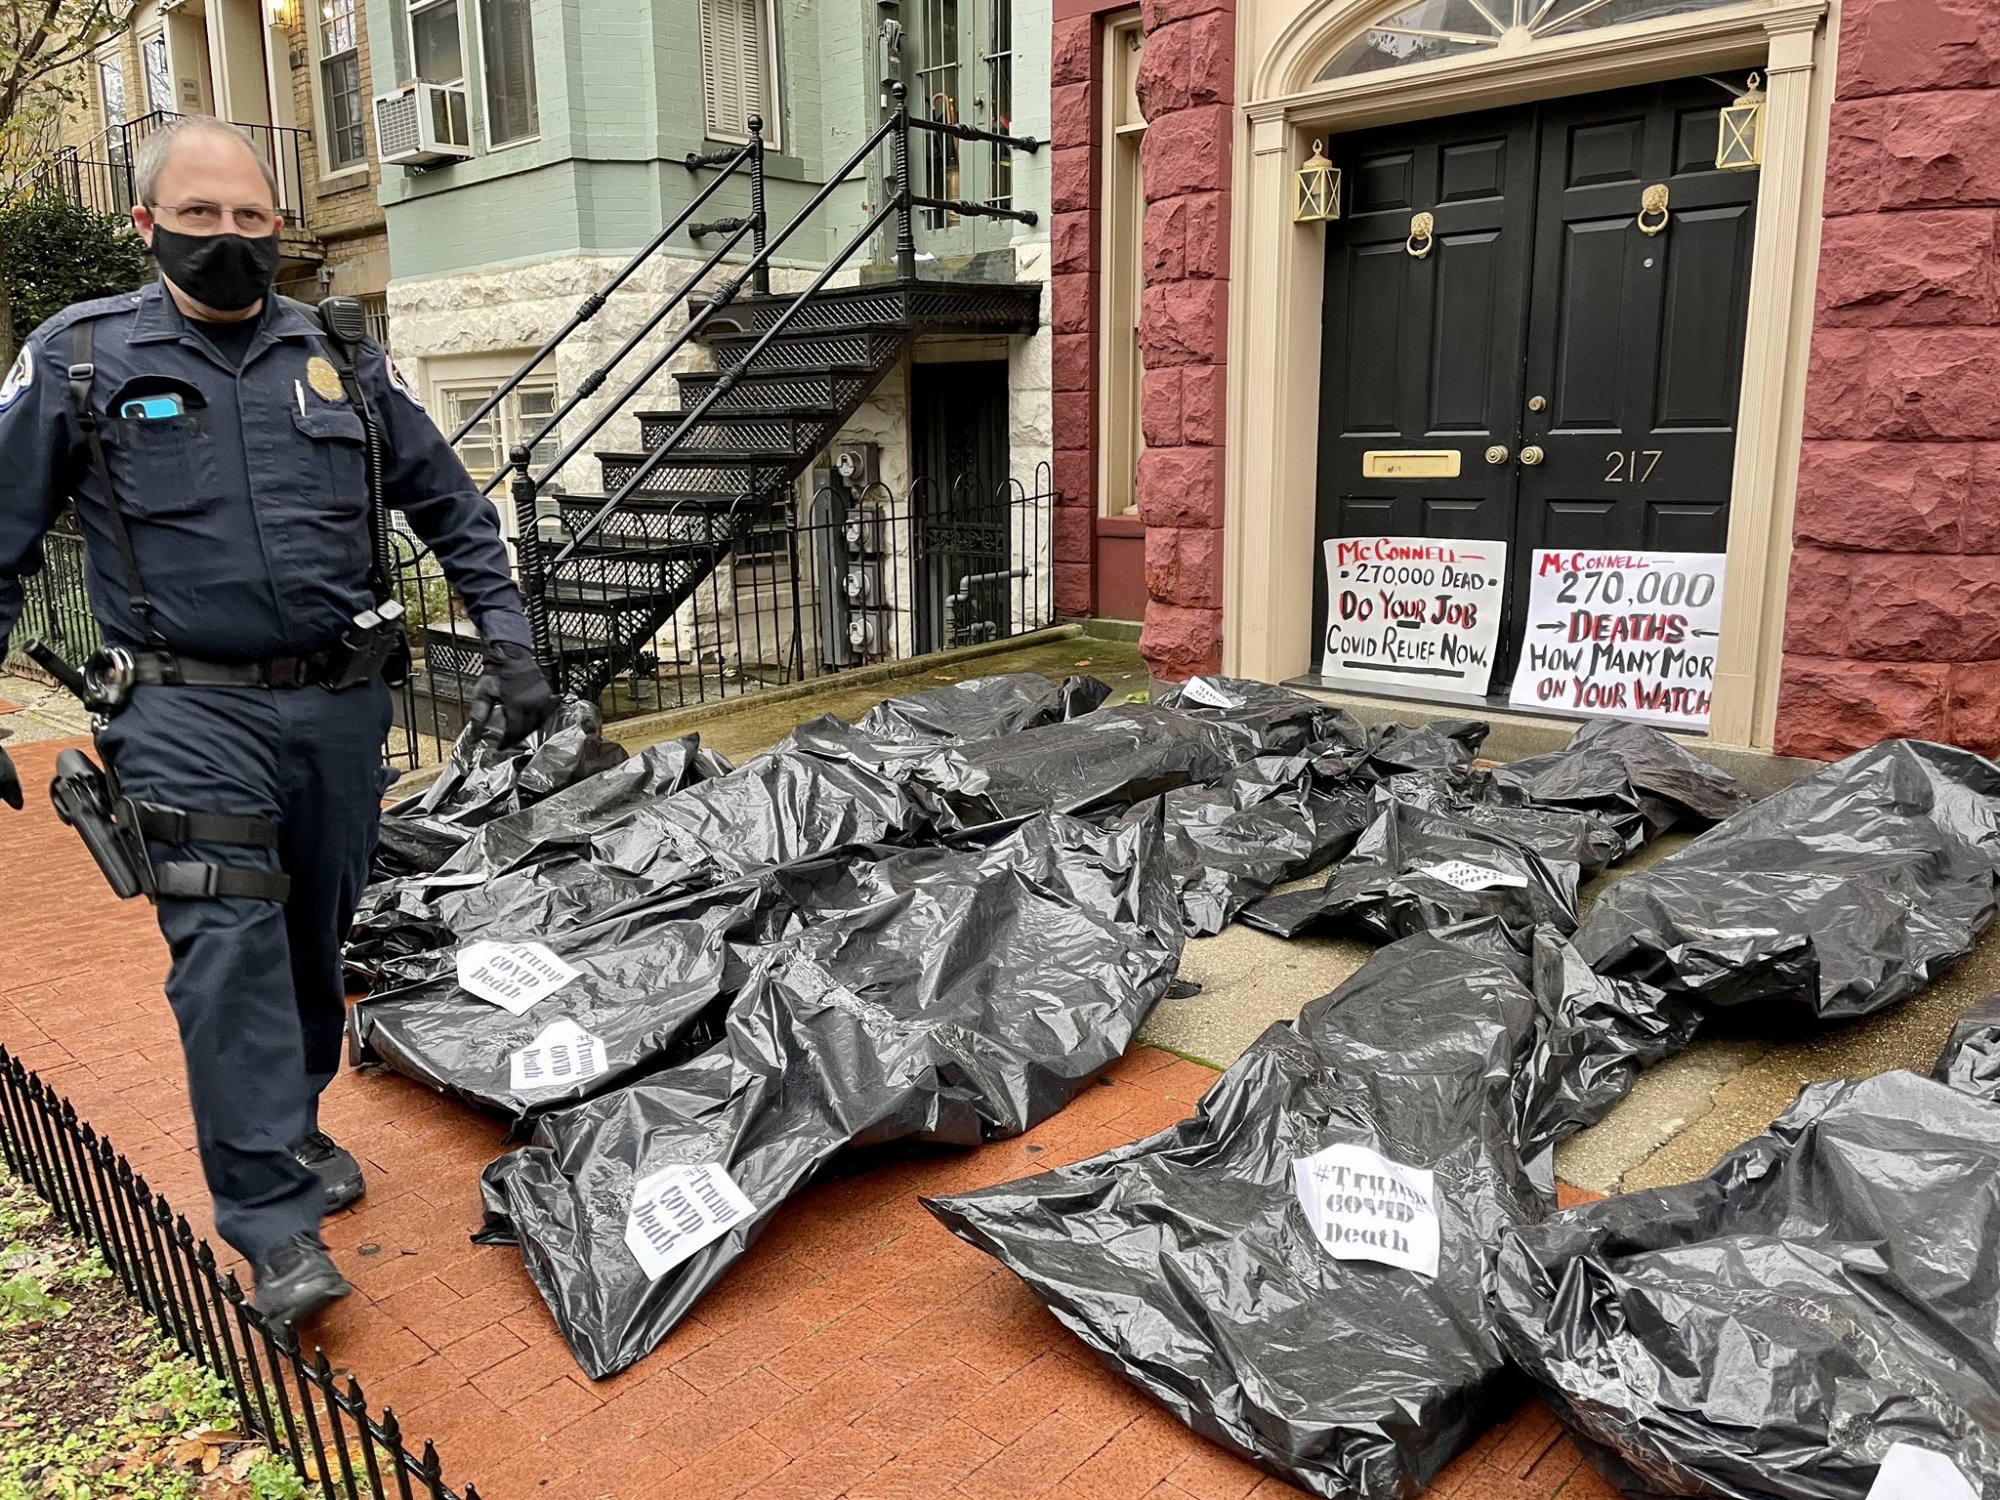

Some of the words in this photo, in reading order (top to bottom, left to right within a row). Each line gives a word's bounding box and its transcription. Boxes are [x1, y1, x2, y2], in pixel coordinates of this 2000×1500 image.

[1604, 450, 1663, 483] 217
[1356, 563, 1435, 587] 270,000
[1441, 564, 1484, 591] DEAD
[1556, 571, 1715, 607] 270,000
[1378, 589, 1427, 623] YOUR
[1431, 595, 1477, 629] JOB
[1567, 609, 1689, 644] DEATHS
[1382, 626, 1435, 664] RELIEF
[1530, 642, 1583, 671] HOW
[1589, 642, 1660, 677] MANY
[1660, 646, 1715, 680] MOR
[1536, 677, 1566, 701] ON
[1572, 675, 1627, 708] YOUR
[1633, 678, 1713, 716] WATCH
[489, 955, 540, 988] COVID
[500, 945, 565, 983] Trump
[469, 966, 521, 999] Death
[523, 1048, 544, 1079] Death
[550, 1044, 571, 1077] COVID
[660, 1185, 705, 1235] COVID
[682, 1165, 740, 1224] #Trump
[1326, 1193, 1415, 1223] COVID
[632, 1199, 683, 1255] Death
[1325, 1222, 1410, 1254] Death
